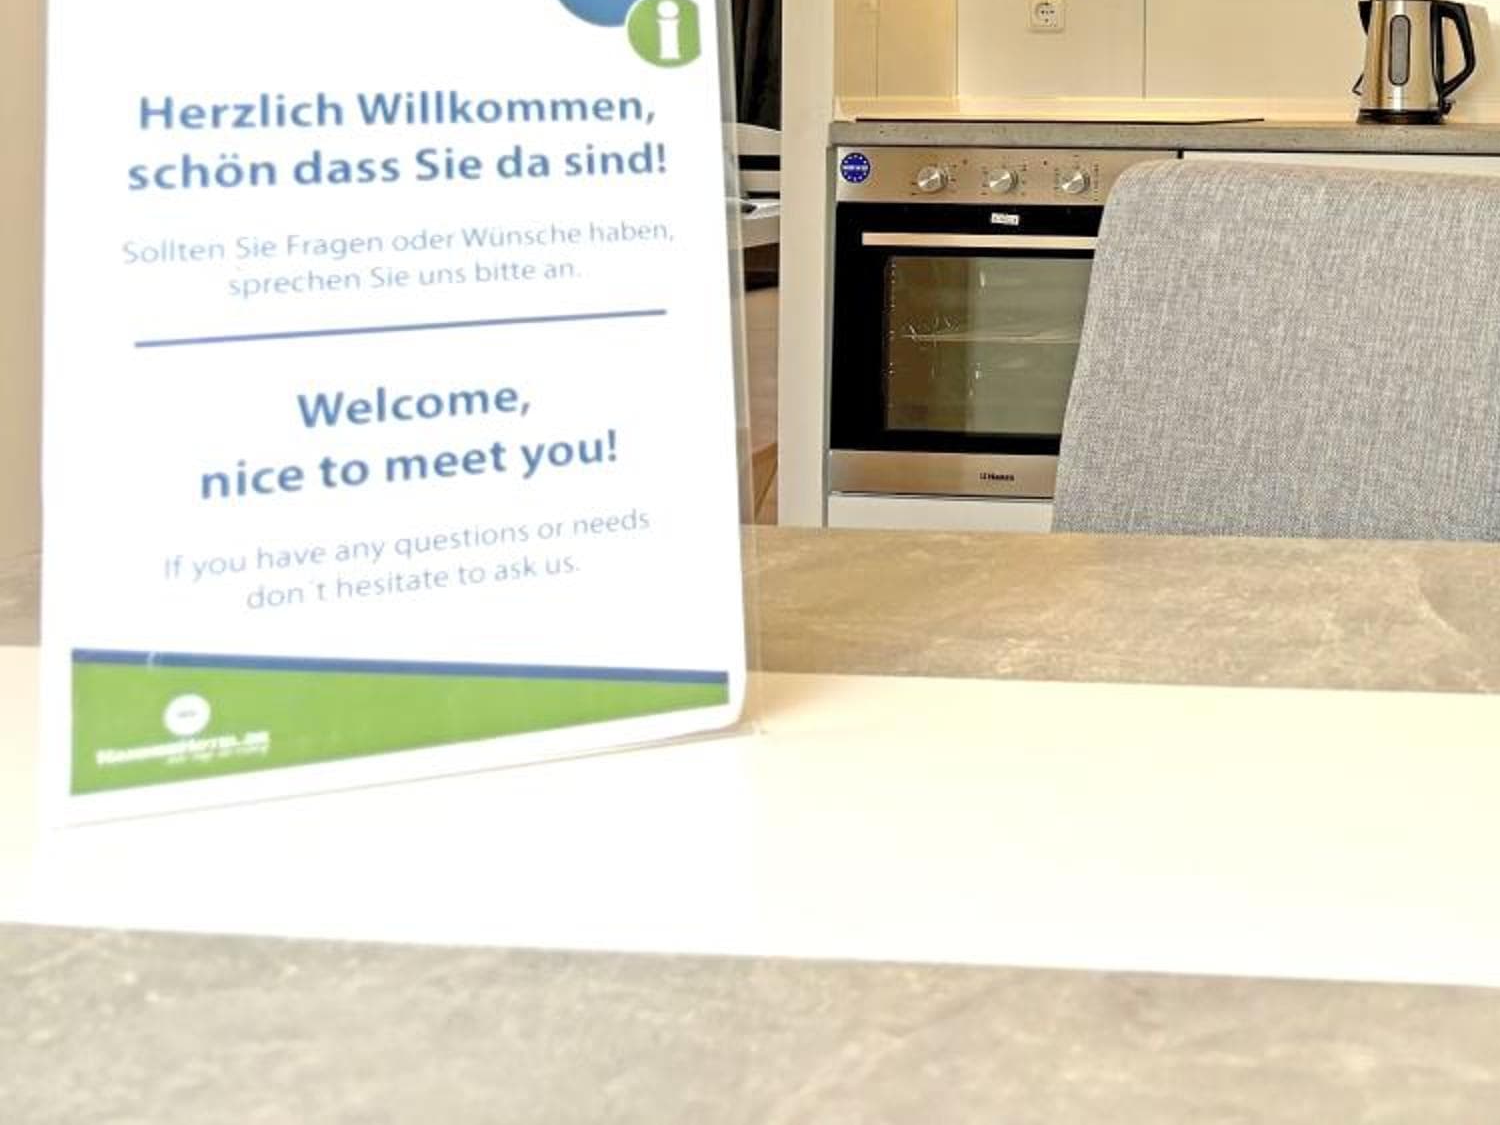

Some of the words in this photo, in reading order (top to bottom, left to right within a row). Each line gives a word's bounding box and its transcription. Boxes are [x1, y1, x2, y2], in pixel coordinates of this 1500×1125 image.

[138, 93, 346, 132] Herzlich
[355, 88, 657, 128] Willkommen,
[127, 150, 279, 193] schön
[291, 148, 401, 188] dass
[414, 145, 486, 184] Sie
[495, 143, 552, 181] da
[562, 139, 669, 179] sind!
[121, 239, 226, 265] Sollten
[235, 235, 279, 261] Sie
[285, 232, 385, 263] Fragen
[390, 227, 456, 253] oder
[459, 223, 583, 250] Wünsche
[588, 219, 676, 245] haben,
[227, 268, 363, 301] sprechen
[368, 266, 411, 290] Sie
[418, 266, 468, 287] uns
[473, 260, 536, 284] bitte
[543, 261, 583, 280] an.
[295, 384, 533, 430] Welcome,
[199, 457, 306, 502] nice
[316, 452, 372, 490] to
[383, 441, 509, 484] meet
[517, 427, 619, 481] you!
[164, 554, 184, 579] If
[191, 557, 247, 583] you
[256, 544, 328, 570] have
[334, 539, 387, 566] any
[392, 523, 530, 561] questions
[536, 522, 564, 540] or
[571, 507, 651, 536] needs
[335, 565, 450, 601] hesitate
[457, 563, 486, 586] to
[493, 556, 539, 582] ask
[544, 554, 582, 576] us.
